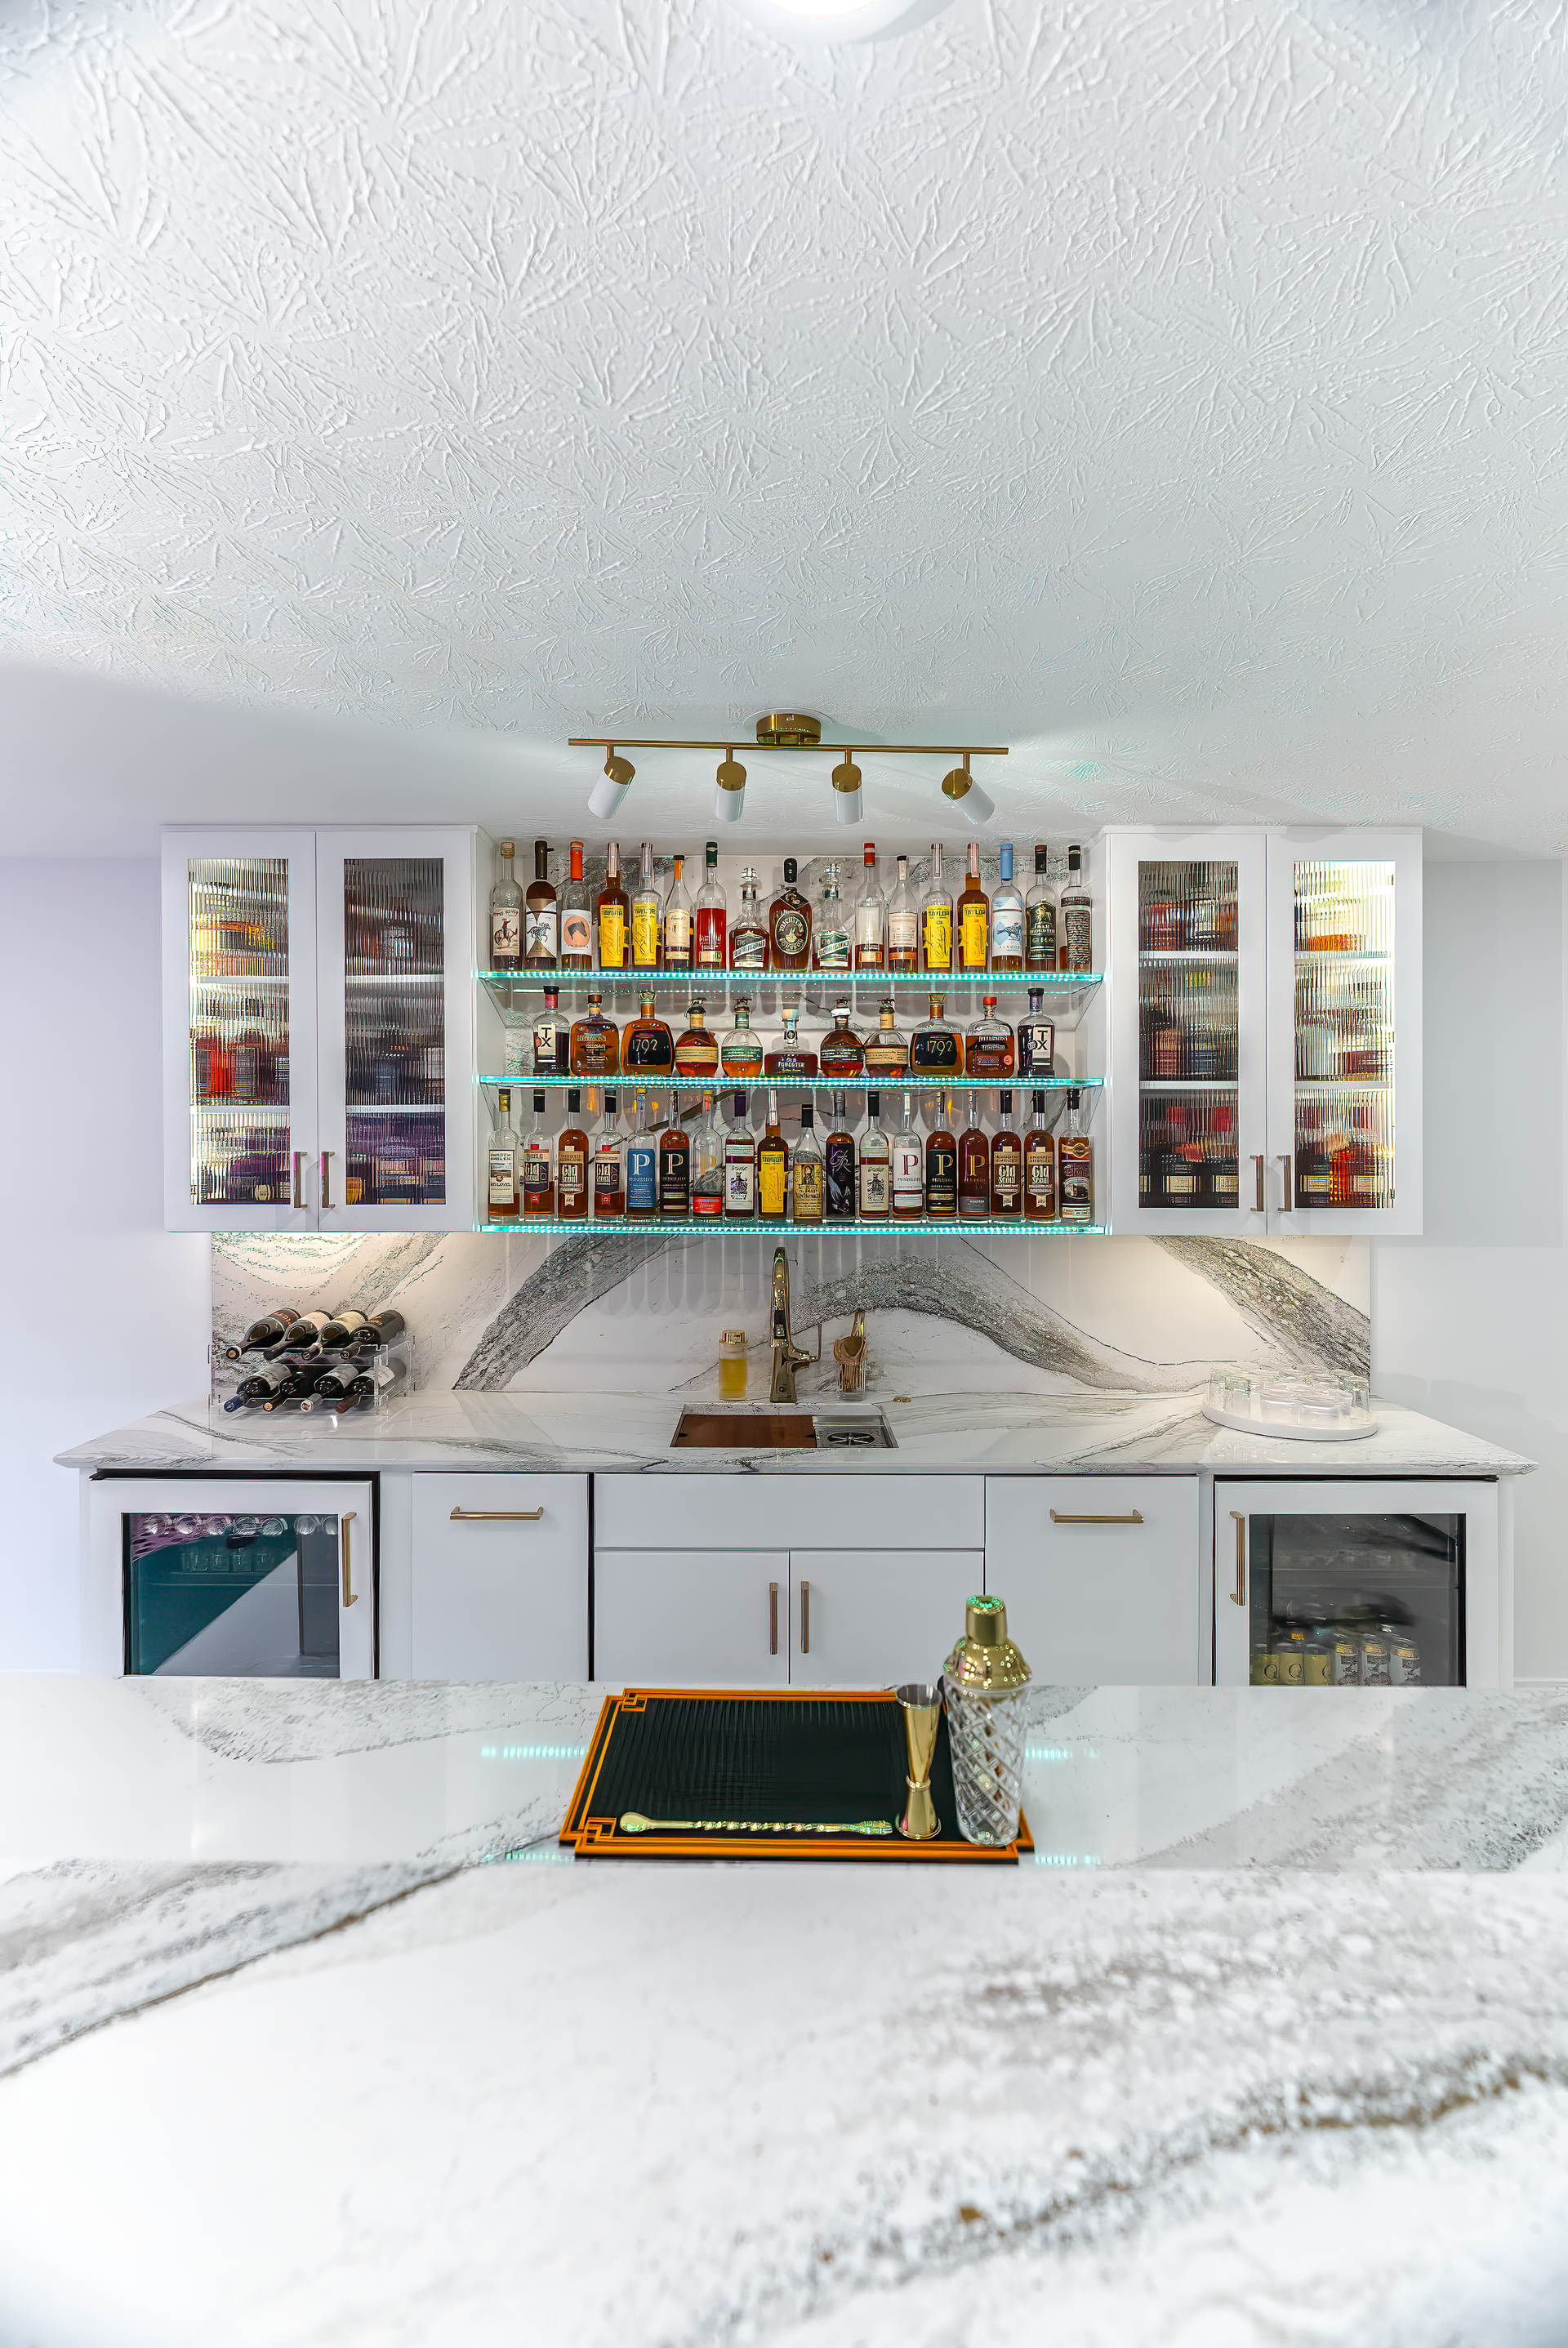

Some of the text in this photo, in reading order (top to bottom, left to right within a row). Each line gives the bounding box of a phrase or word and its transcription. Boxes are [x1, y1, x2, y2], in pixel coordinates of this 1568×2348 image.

[632, 1039, 658, 1055] 1792
[927, 1040, 953, 1056] 1792
[632, 1153, 651, 1175] P
[666, 1153, 684, 1175] P
[902, 1154, 919, 1176] P
[935, 1154, 954, 1176] P
[968, 1154, 986, 1176] P
